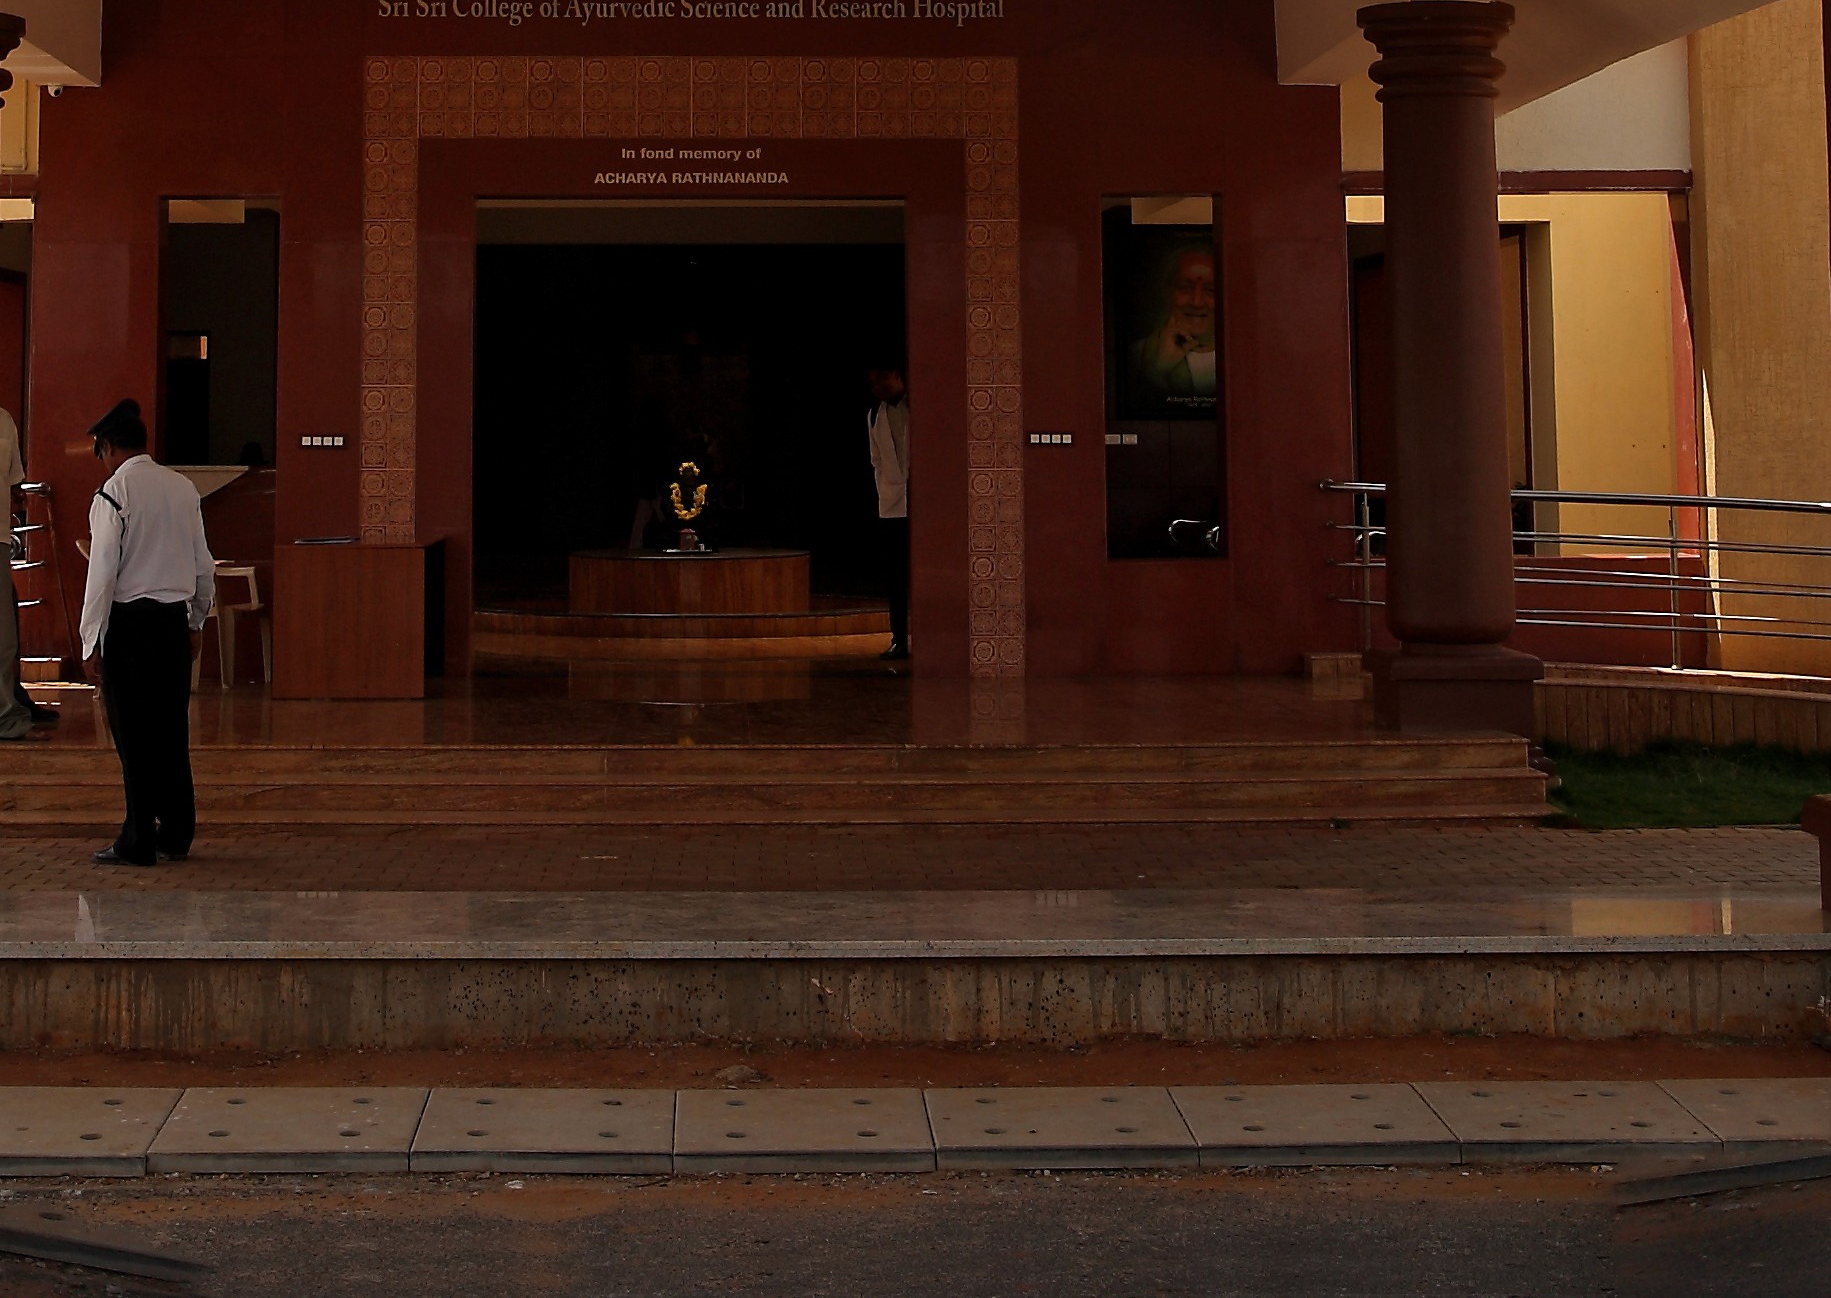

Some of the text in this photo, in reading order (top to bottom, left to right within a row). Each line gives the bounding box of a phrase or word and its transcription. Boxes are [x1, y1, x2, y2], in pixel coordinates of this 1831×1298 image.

[621, 147, 762, 162] In fond memory of
[594, 172, 789, 184] ACHARYA RATHNANANDA
